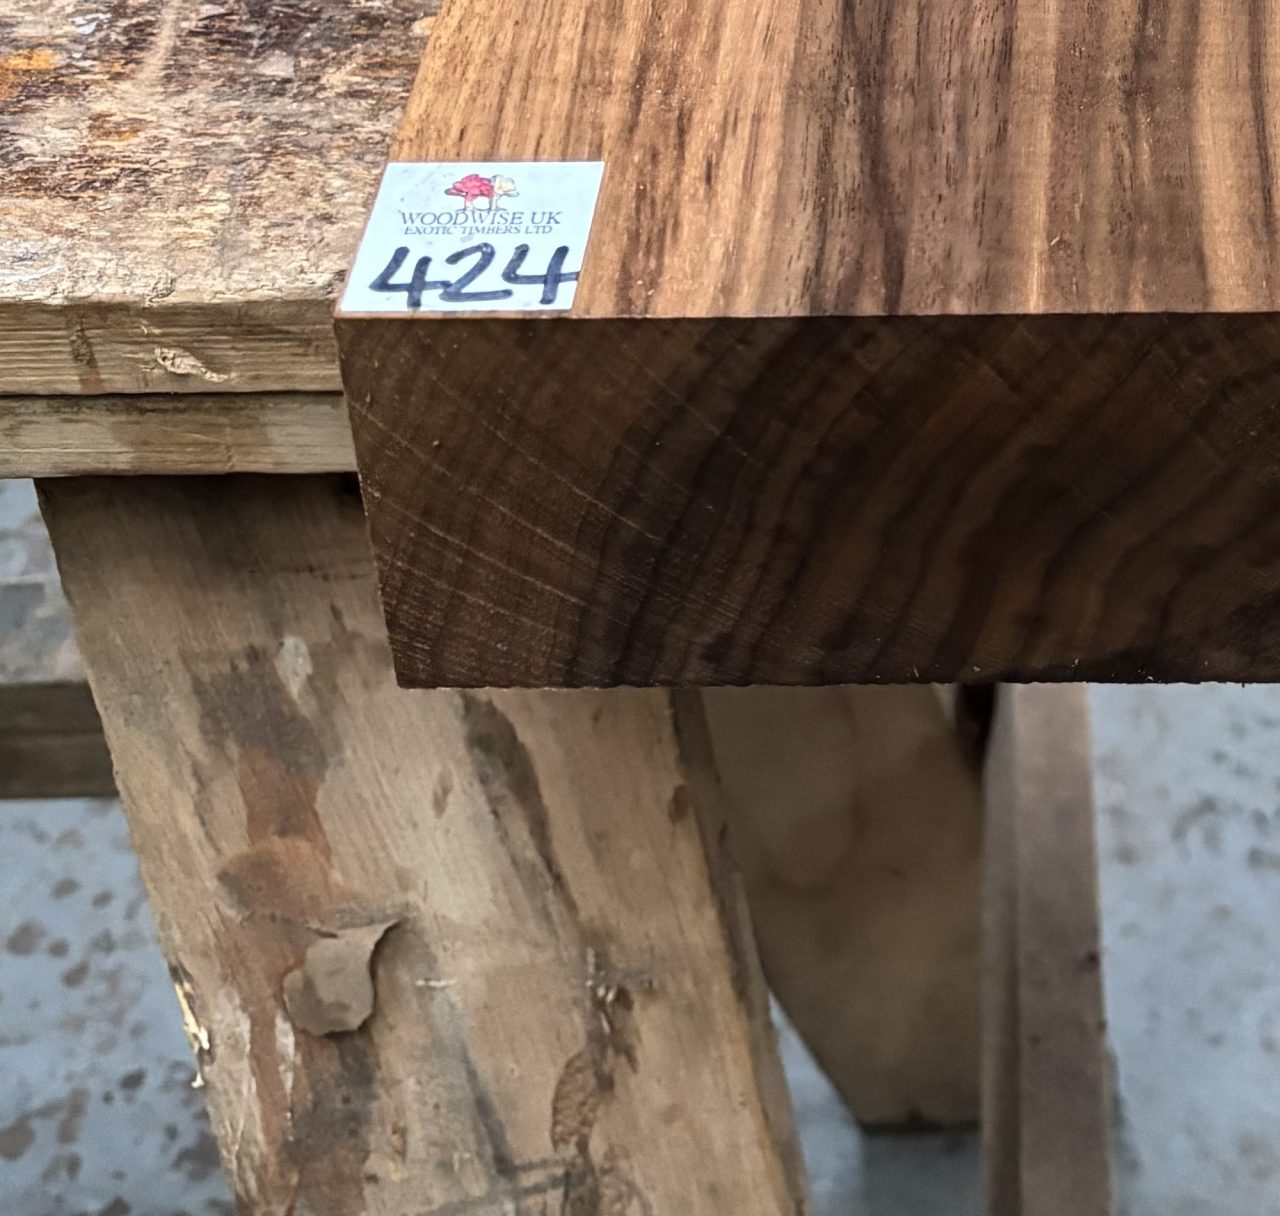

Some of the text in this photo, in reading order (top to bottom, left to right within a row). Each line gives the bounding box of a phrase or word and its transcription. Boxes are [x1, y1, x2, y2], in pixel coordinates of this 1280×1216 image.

[401, 211, 562, 225] WOODWISE UK
[404, 225, 552, 235] EXOTIC TIMBERS LTD
[368, 242, 581, 308] 424
